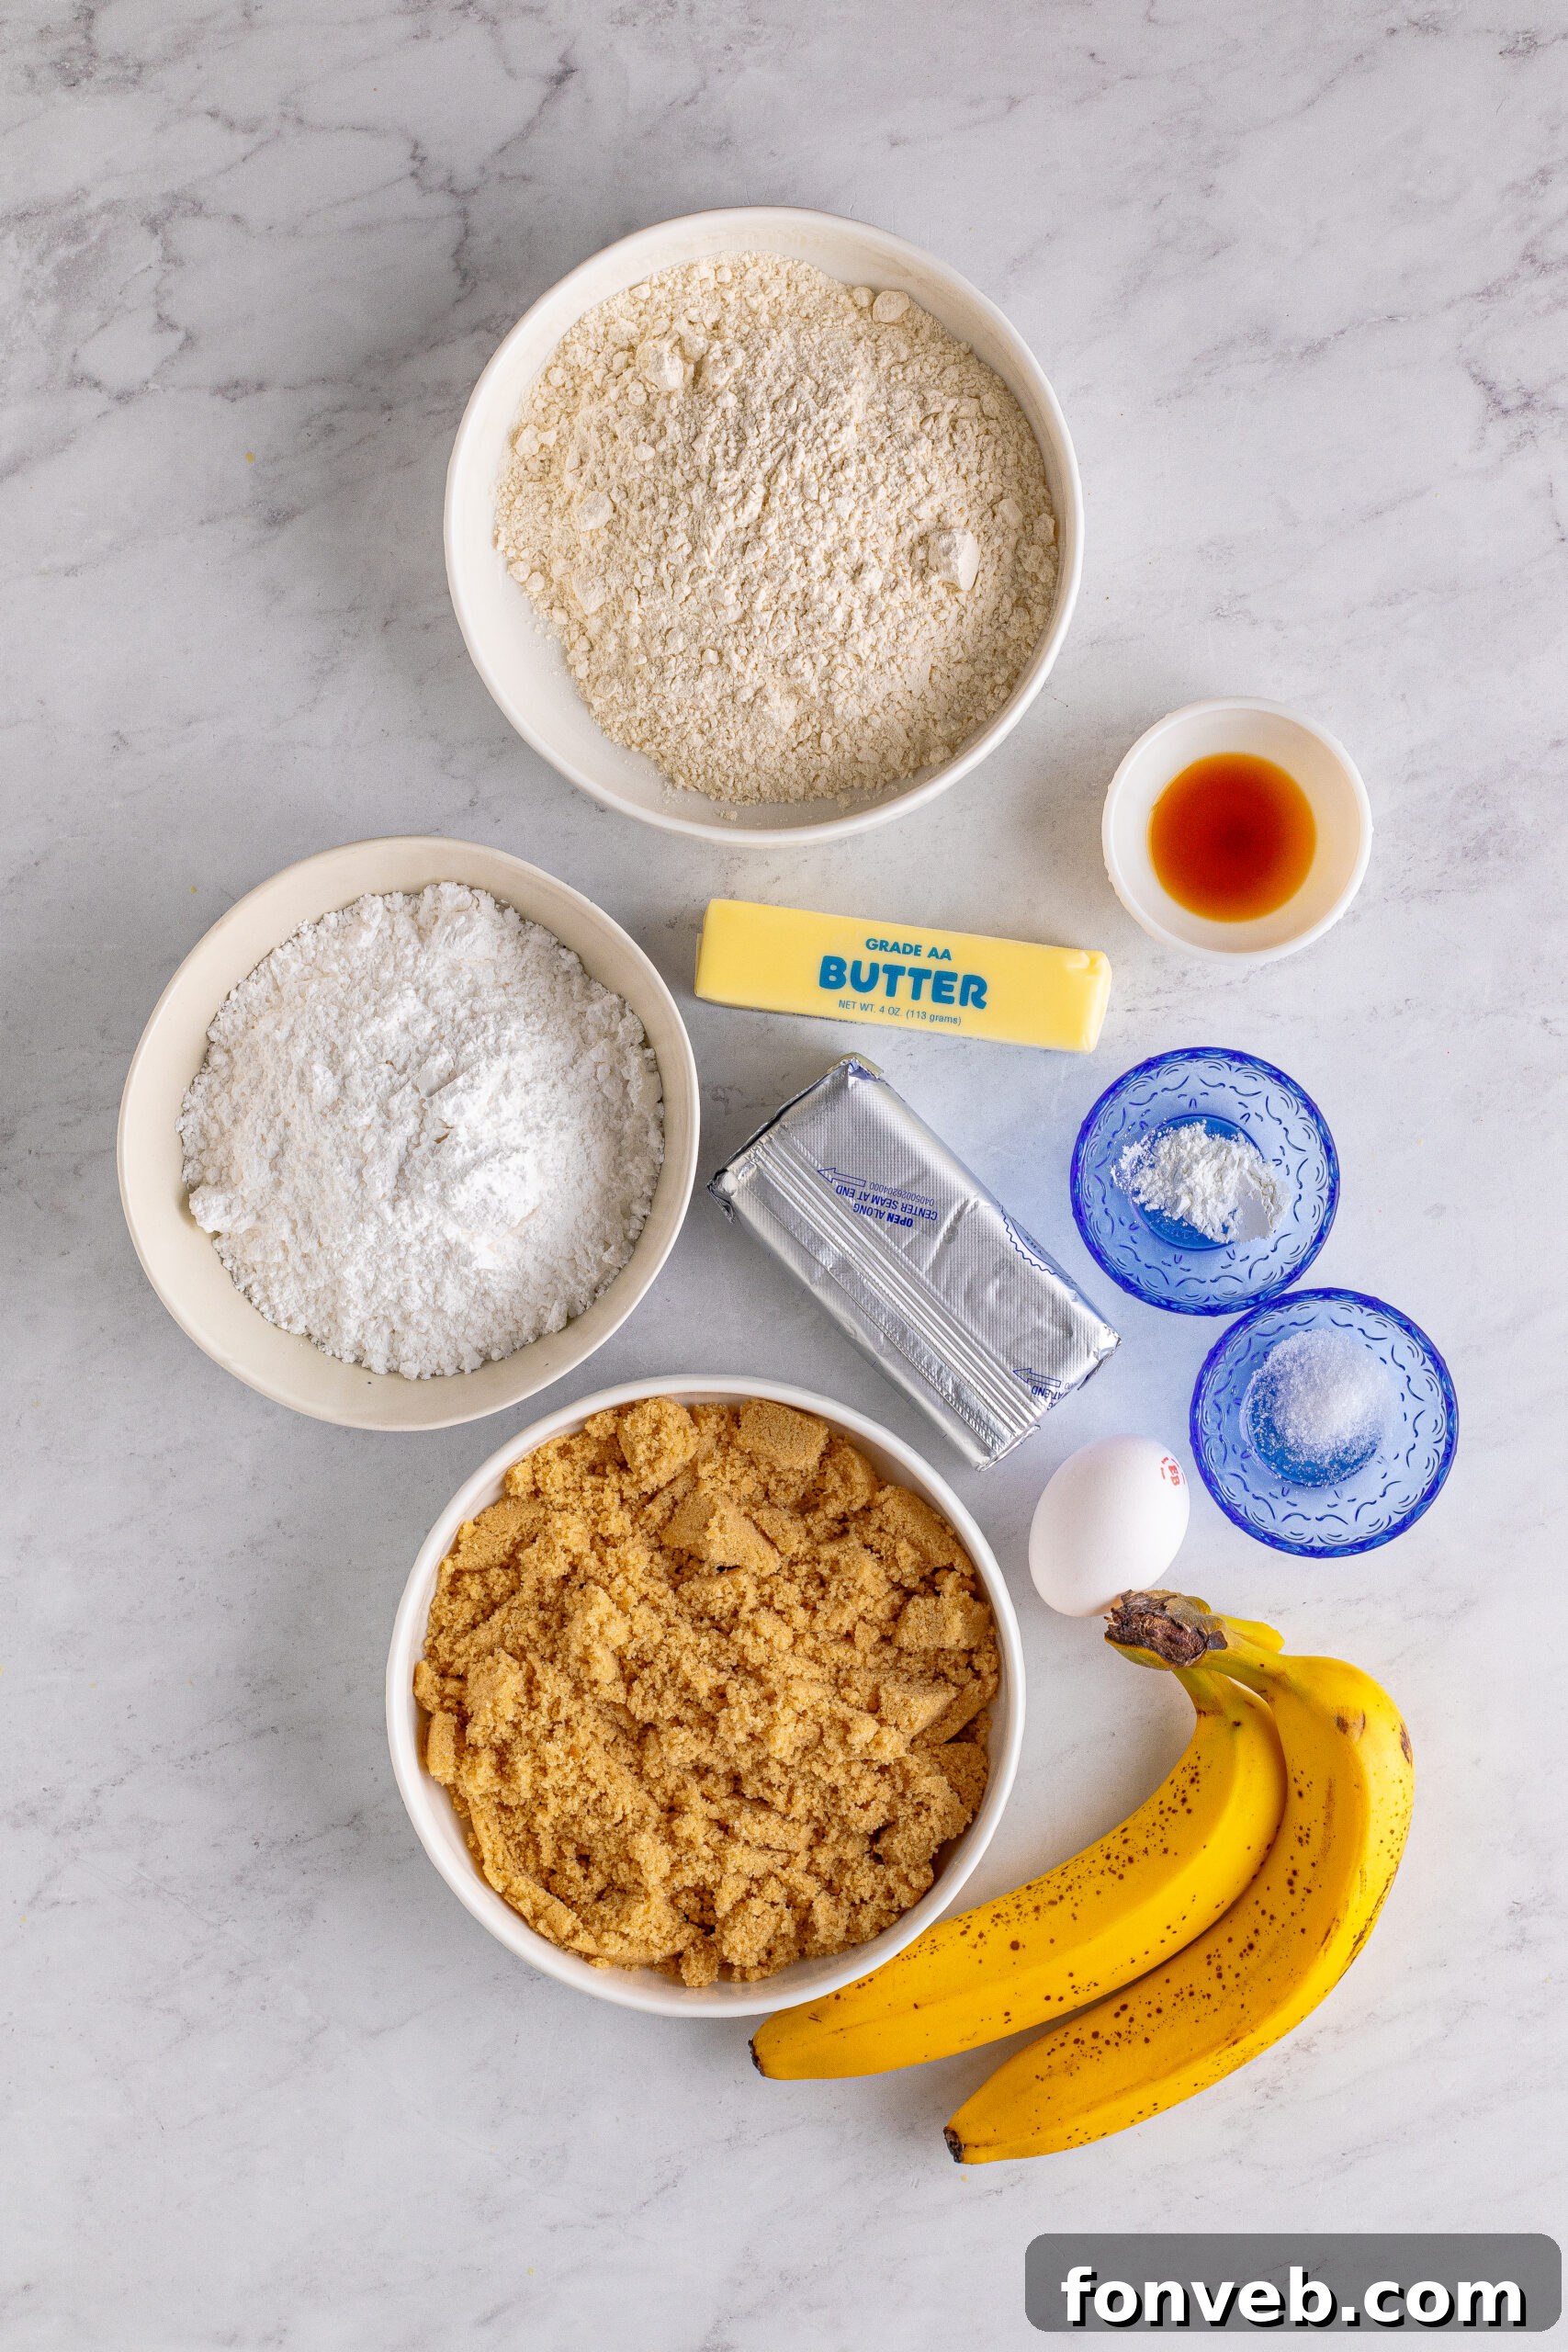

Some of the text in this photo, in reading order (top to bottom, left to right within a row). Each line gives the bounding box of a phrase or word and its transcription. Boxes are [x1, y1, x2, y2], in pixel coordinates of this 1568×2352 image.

[865, 937, 952, 961] GRADE AA
[818, 955, 988, 1010] BUTTER
[839, 999, 962, 1026] NET WT. 4 OZ. (113 grams)
[835, 1184, 938, 1221] CENTER SEAM AT END
[852, 1203, 913, 1227] OPEN ALONG
[1031, 1385, 1052, 1398] END
